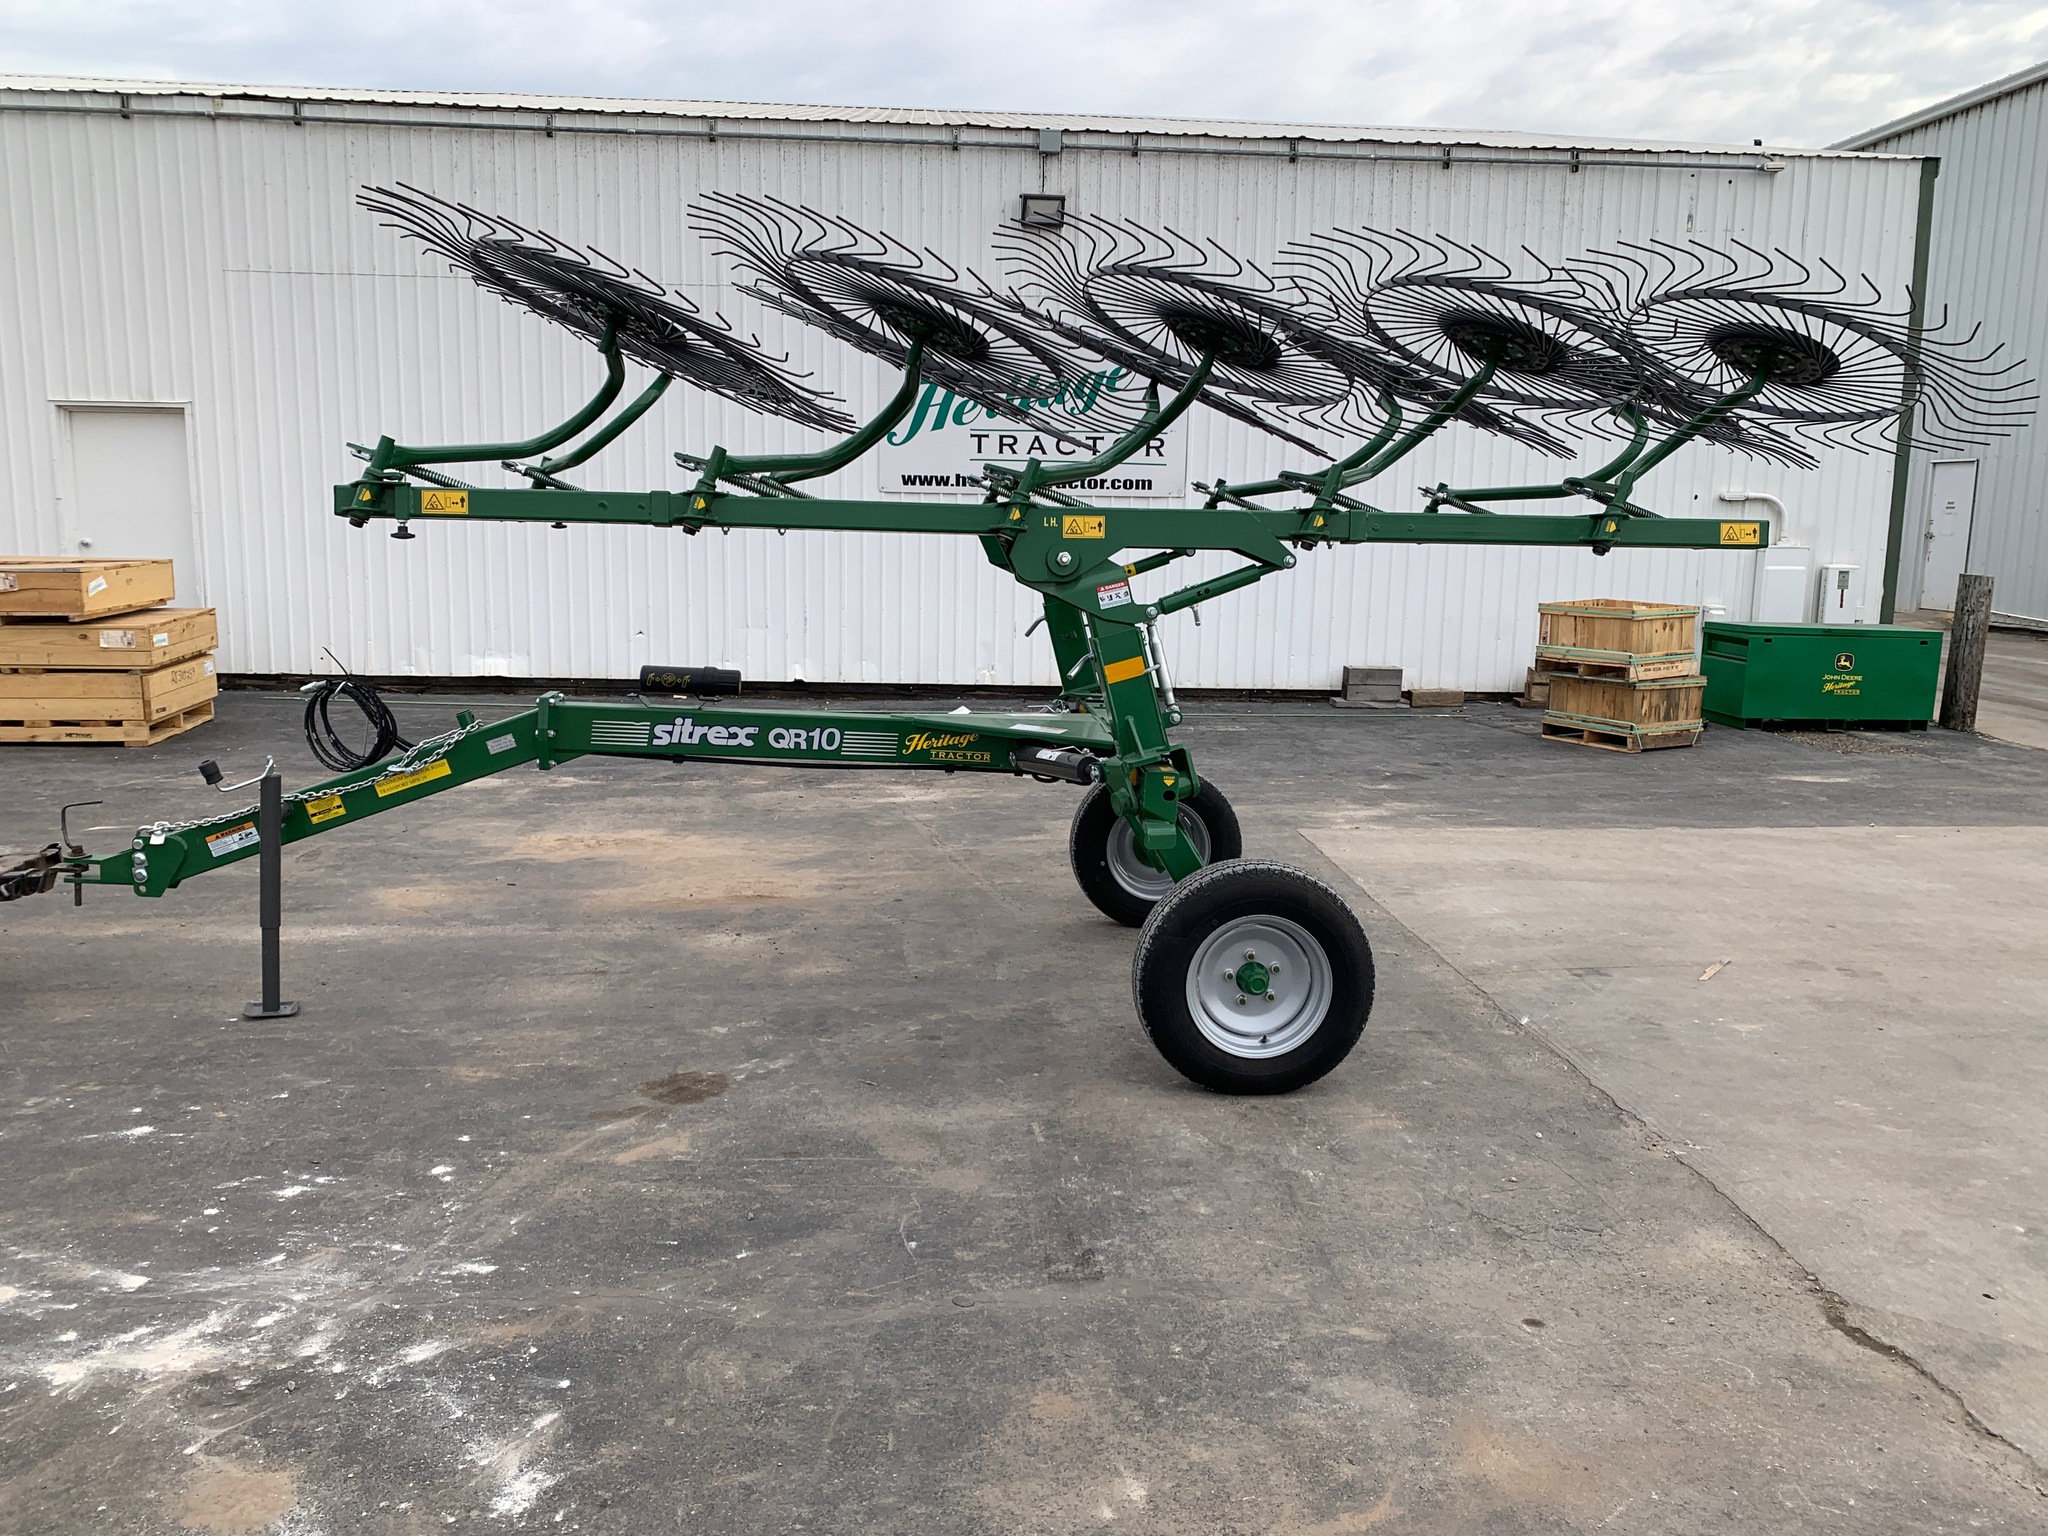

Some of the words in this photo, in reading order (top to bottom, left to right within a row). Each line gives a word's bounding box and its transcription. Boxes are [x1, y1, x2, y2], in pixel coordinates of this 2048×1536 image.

[886, 365, 1136, 446] Hetage
[970, 432, 1165, 457] TRACTR
[652, 717, 759, 747] sitrex
[768, 727, 841, 750] QR10
[902, 731, 979, 755] Heritage
[930, 751, 991, 761] TRACTOR
[431, 761, 446, 771] ROAD
[380, 782, 409, 795] TRANSPORT
[220, 825, 246, 836] WARNING
